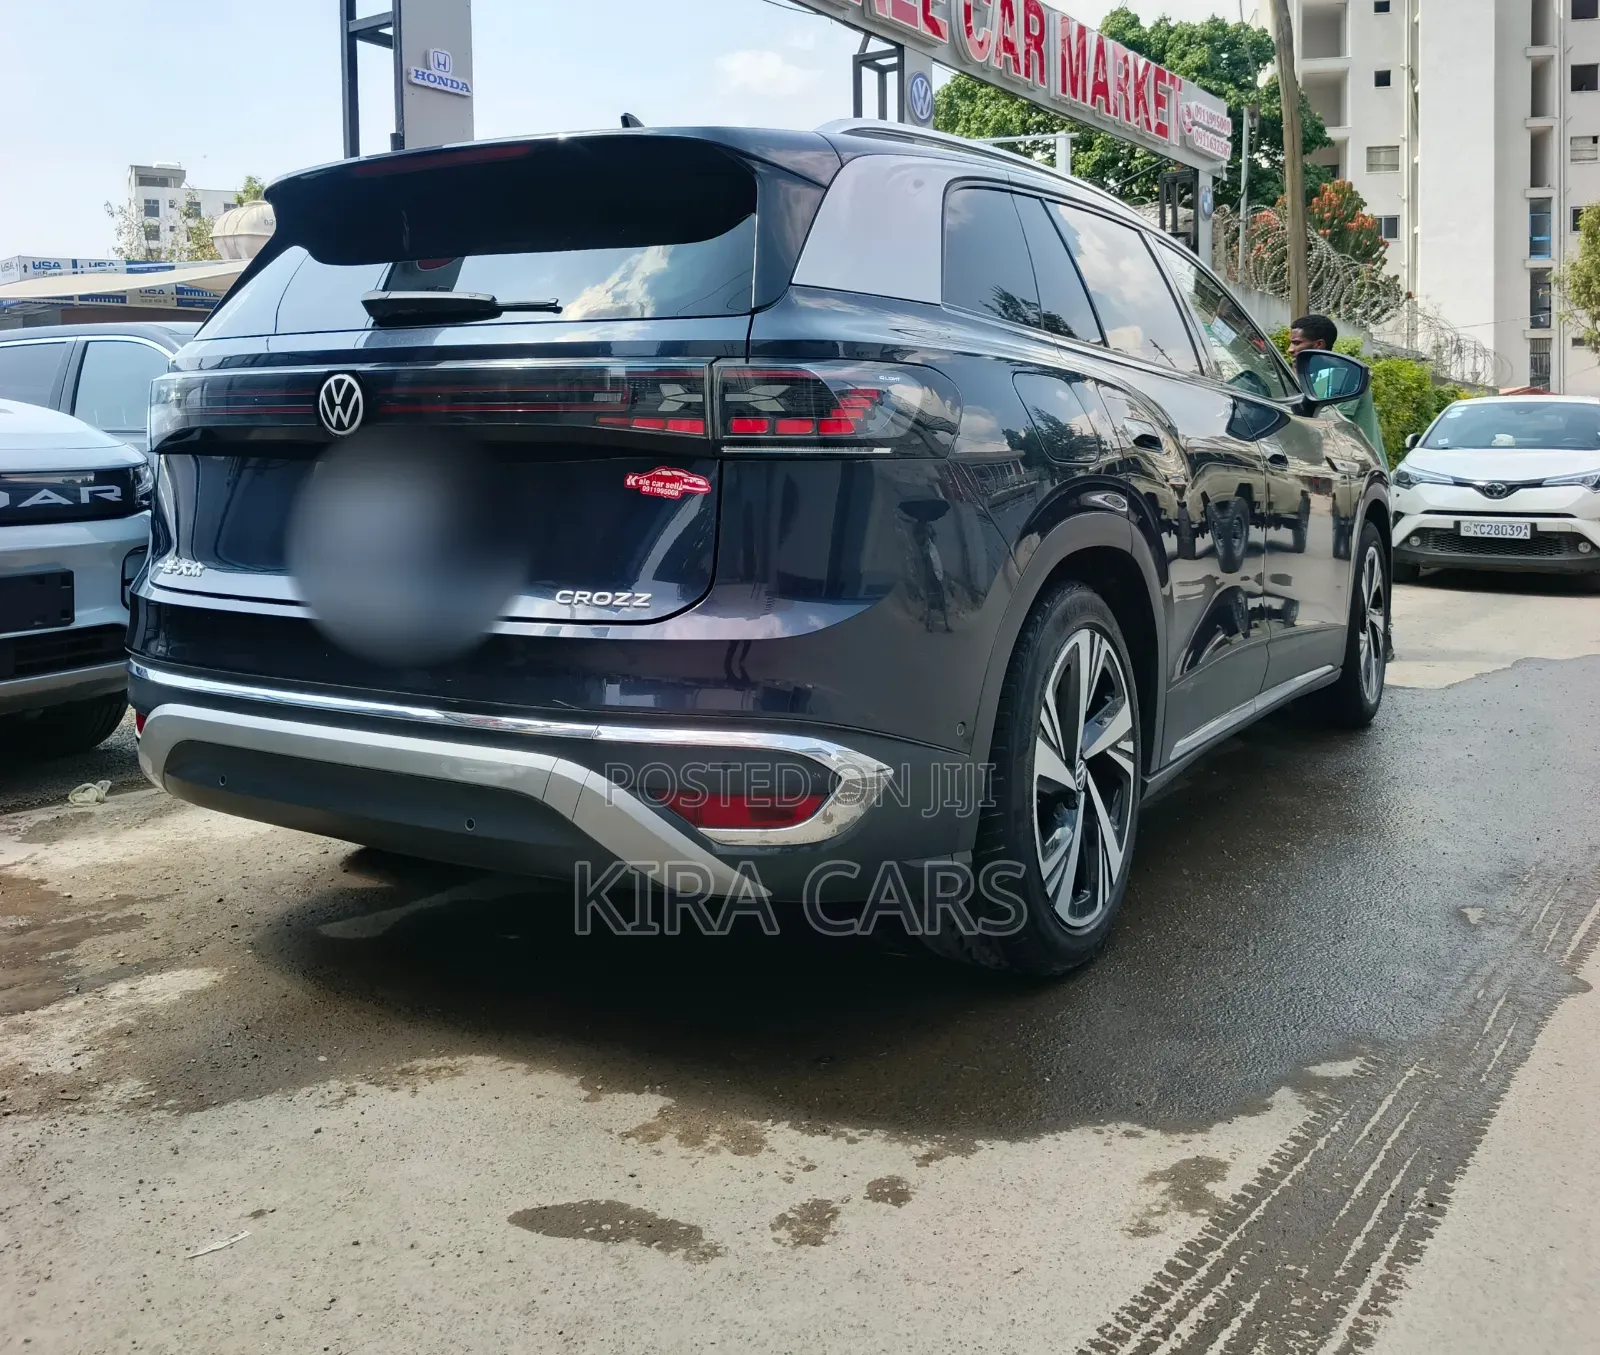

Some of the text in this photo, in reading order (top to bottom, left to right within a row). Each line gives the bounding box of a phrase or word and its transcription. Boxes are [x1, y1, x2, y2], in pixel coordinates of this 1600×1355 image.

[413, 68, 471, 93] HONDA
[1060, 15, 1184, 147] MARKET
[32, 260, 62, 271] USA
[651, 479, 665, 488] car
[0, 485, 123, 508] AR
[1479, 524, 1523, 537] C28039
[555, 590, 652, 607] CROZZ
